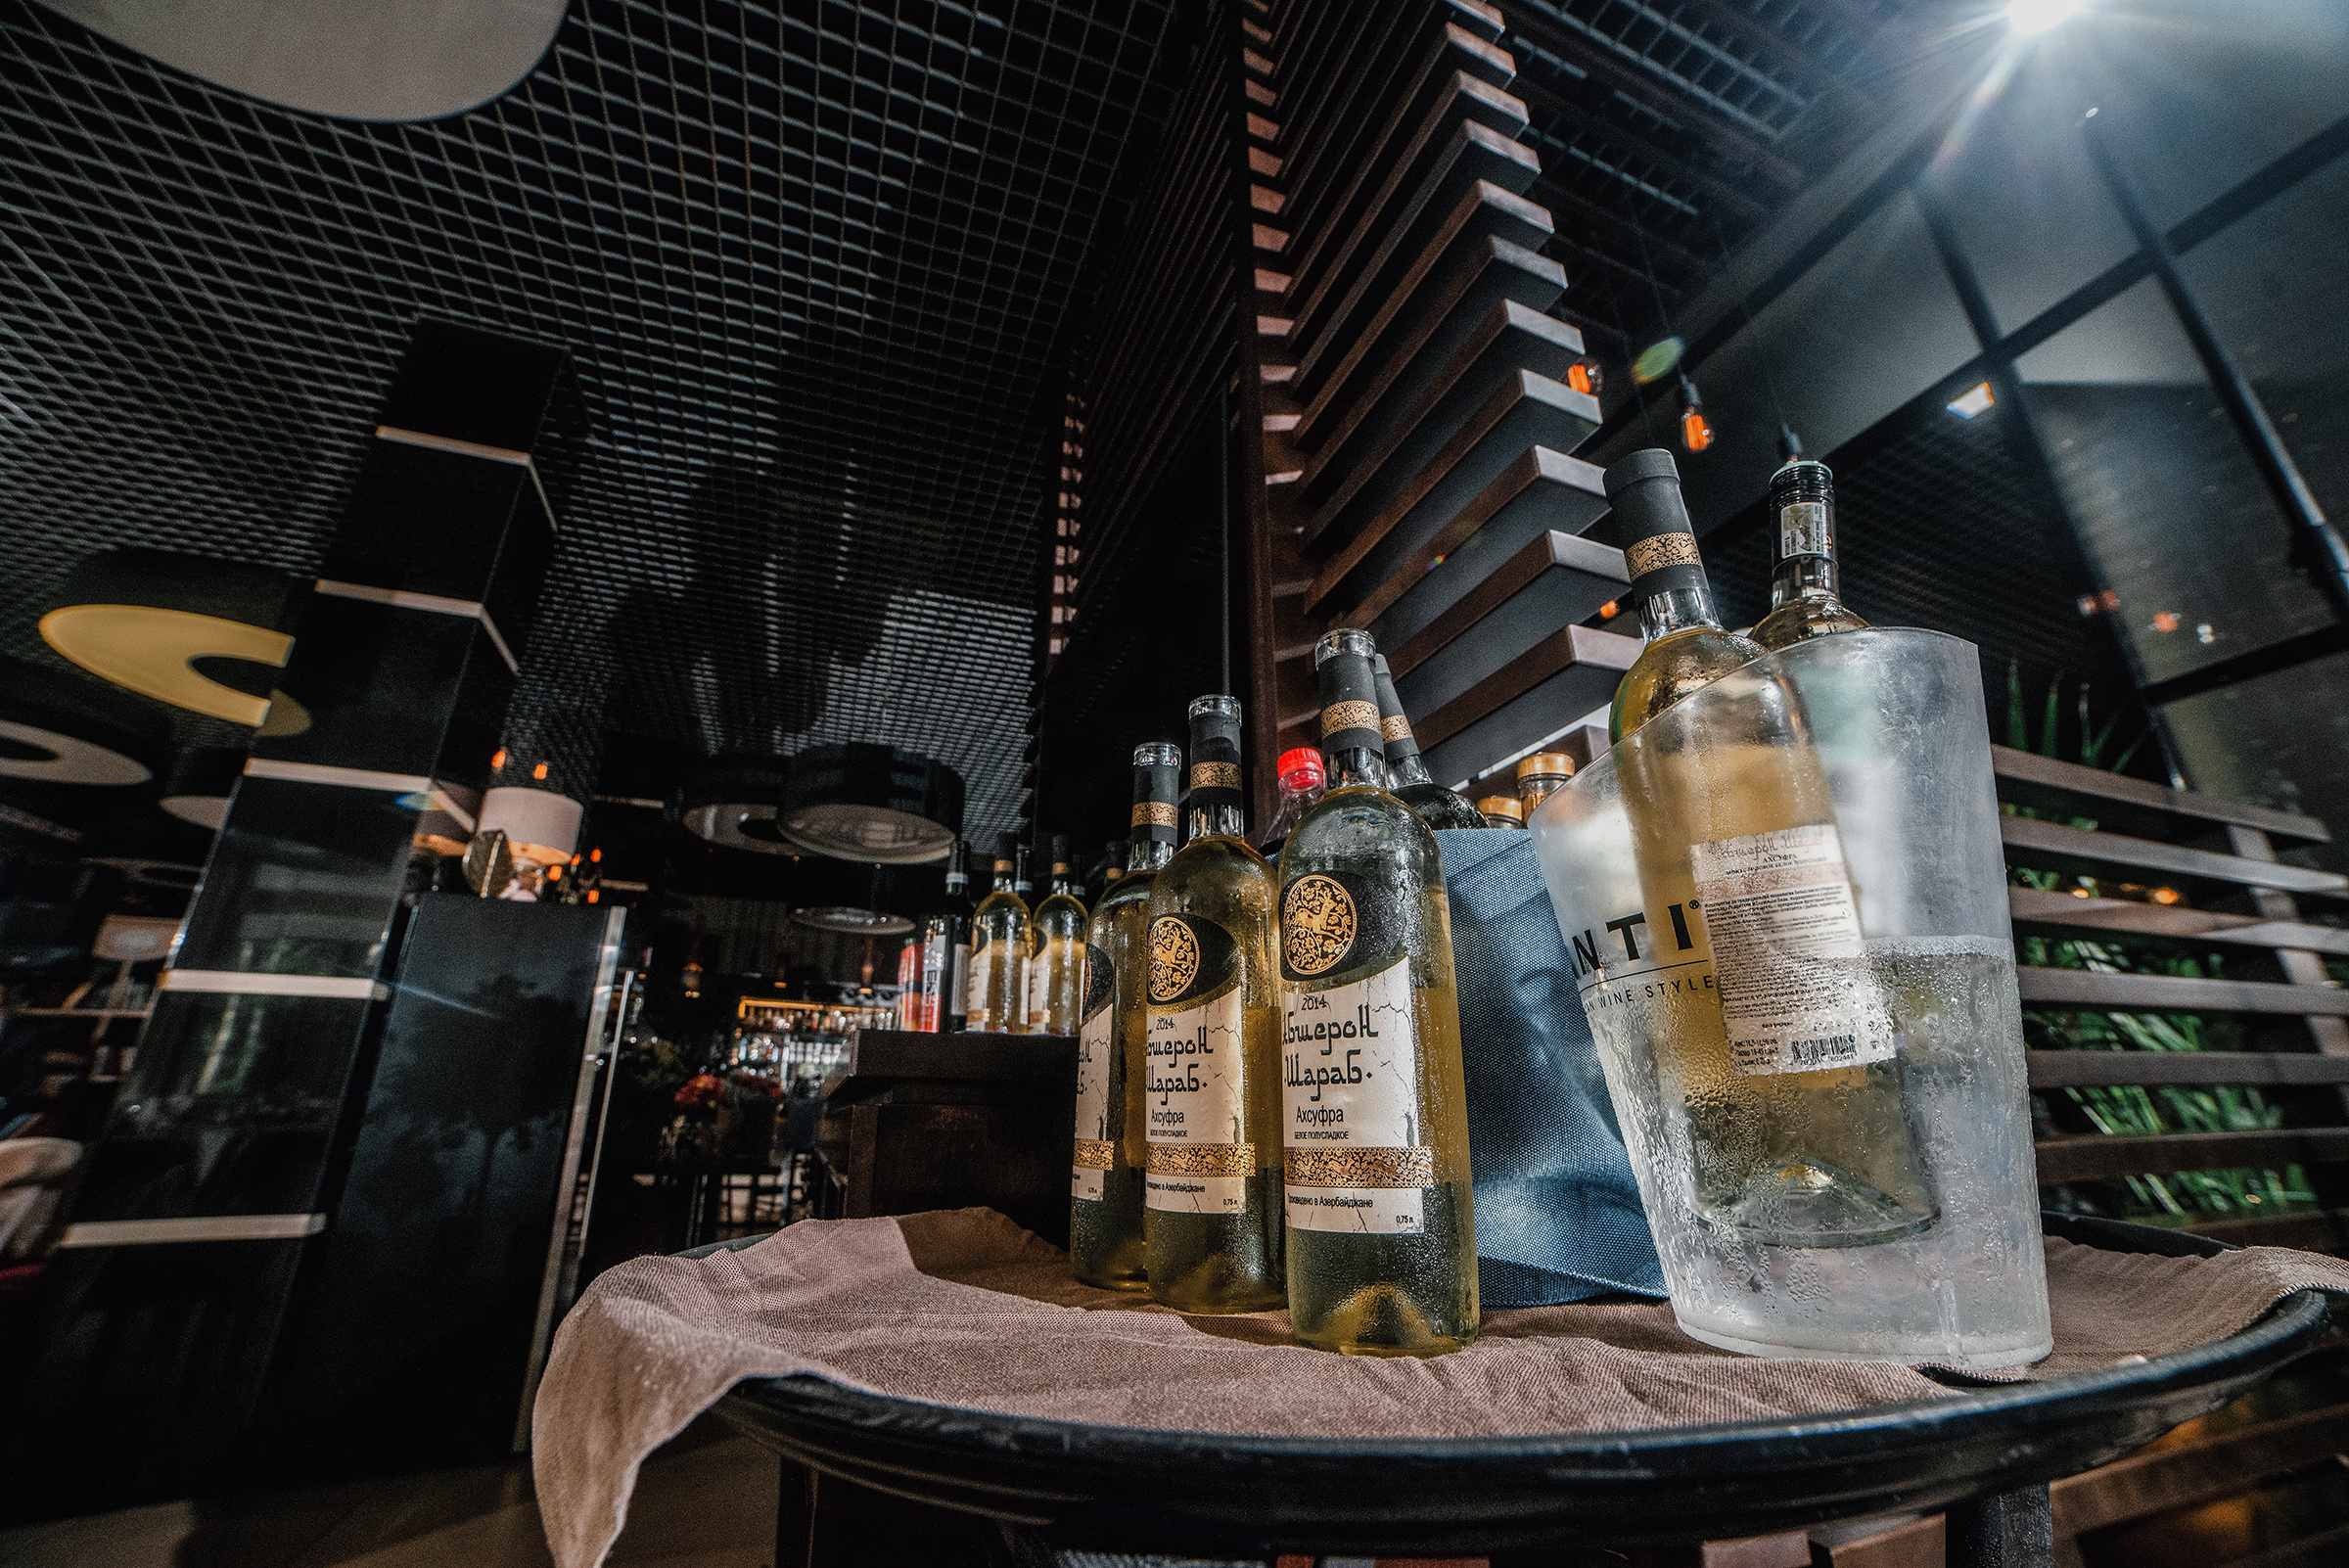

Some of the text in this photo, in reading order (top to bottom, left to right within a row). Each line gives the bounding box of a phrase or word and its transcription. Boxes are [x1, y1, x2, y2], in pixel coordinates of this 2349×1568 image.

[1597, 989, 1634, 1008] WINE
[1644, 975, 1714, 998] STYLE
[1301, 994, 1327, 1011] 2014
[1156, 1017, 1174, 1031] 2014
[1151, 1108, 1184, 1127] Ахсуфра
[1296, 1105, 1344, 1127] Ахсуфра
[1318, 1195, 1373, 1210] Азербайджане
[1396, 1216, 1408, 1224] 0,75
